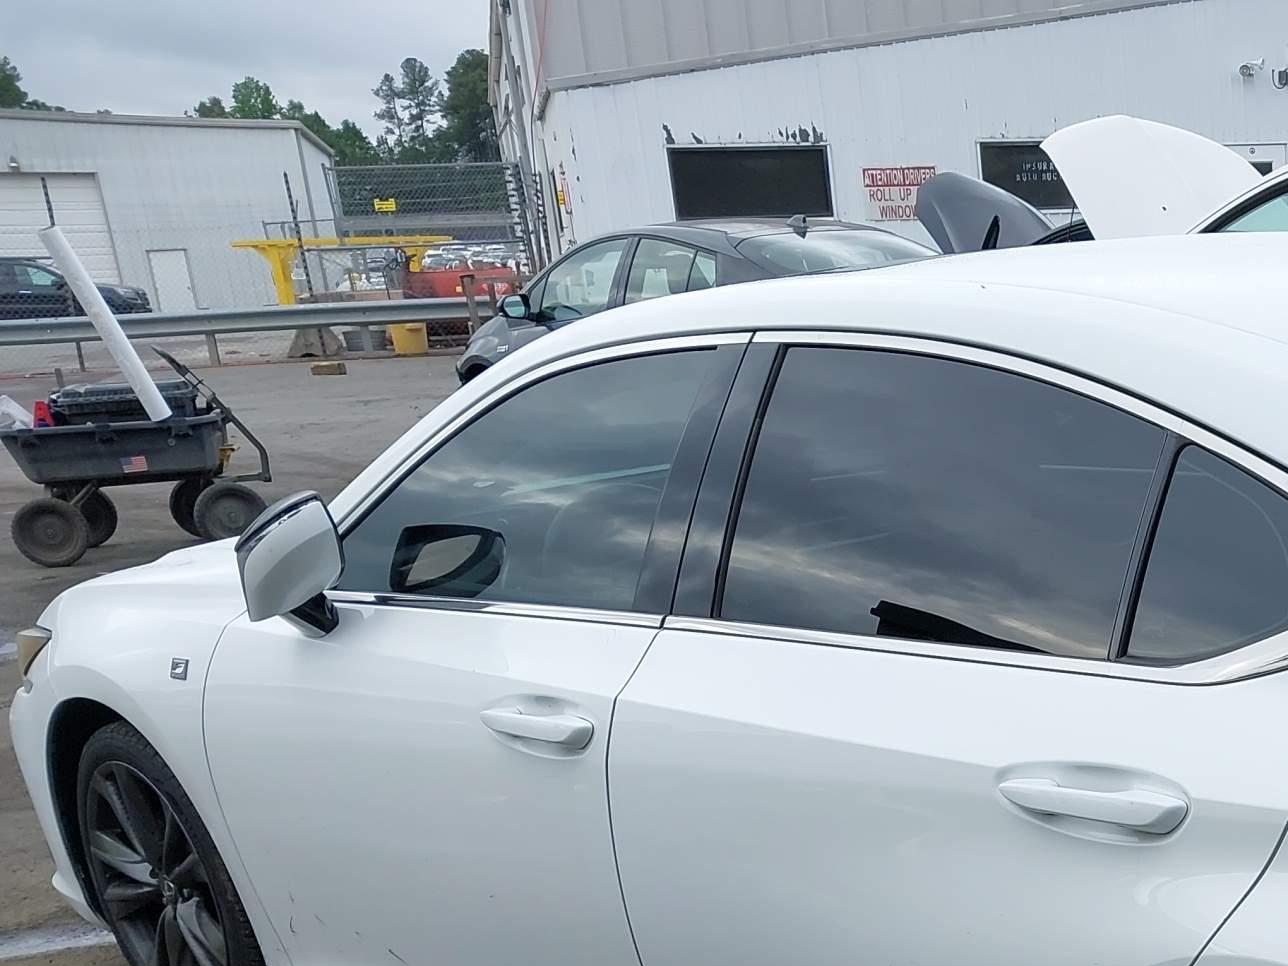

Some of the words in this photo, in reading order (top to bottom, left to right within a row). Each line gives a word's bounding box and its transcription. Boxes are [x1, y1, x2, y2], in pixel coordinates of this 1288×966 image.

[864, 169, 904, 186] ATTENTION
[904, 168, 935, 185] DRIVERS
[869, 188, 895, 202] ROLL
[898, 188, 912, 202] UP
